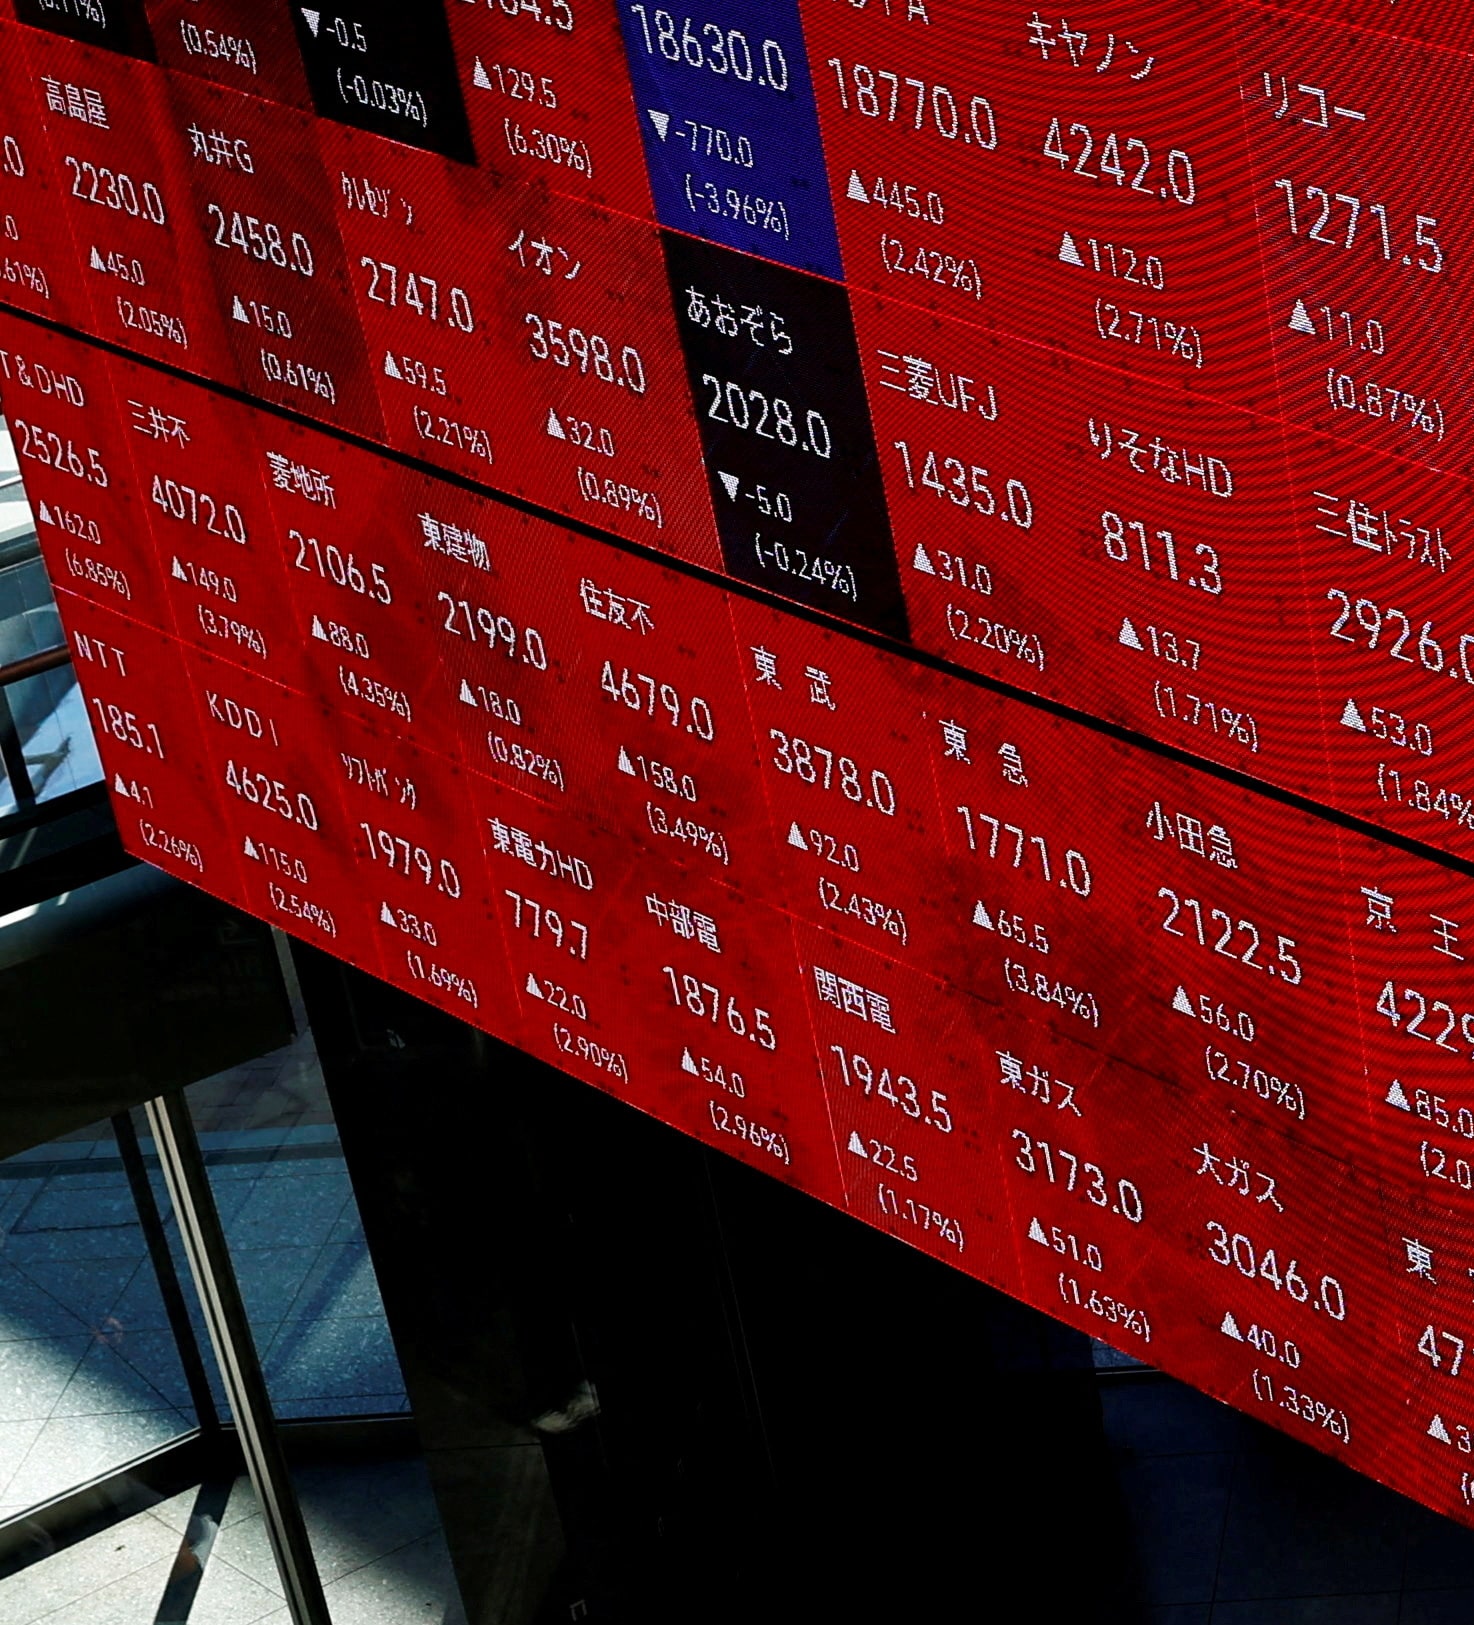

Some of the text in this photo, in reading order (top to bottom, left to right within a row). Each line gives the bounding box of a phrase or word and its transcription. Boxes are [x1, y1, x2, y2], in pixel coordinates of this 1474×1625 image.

[326, 17, 367, 52] -0.5
[631, 4, 788, 91] 18630.0
[1027, 11, 1154, 80] キヤノン
[493, 64, 557, 108] 129.5
[828, 58, 997, 150] 18770.0
[1263, 72, 1366, 128] リコー
[187, 122, 255, 175] 丸井G
[504, 118, 592, 179] (6.30%)
[676, 120, 753, 168] -770.0
[1043, 117, 1197, 206] 4242.0
[65, 156, 165, 225] 2230.0
[685, 173, 789, 240] (-3.96%)
[208, 204, 314, 277] 2458.0
[508, 230, 582, 281] イオン
[1275, 178, 1443, 274] 1271.5
[361, 256, 475, 333] 2747.0
[685, 286, 793, 355] あおぞら
[525, 313, 646, 393] 3598.0
[1095, 298, 1203, 369] (2.71%)
[702, 373, 831, 459] 2028.0
[877, 350, 999, 422] 三菱UFJ
[17, 420, 108, 488] 2526.5
[128, 399, 191, 449] 三井不
[1088, 418, 1233, 498] りそなHD
[152, 475, 247, 545] 4072.0
[745, 485, 792, 523] -5.0
[894, 441, 1032, 529] 1435.0
[289, 529, 391, 605] 2106.5
[417, 512, 492, 572] 東建物
[755, 532, 857, 602] (-0.24%)
[1101, 510, 1223, 595] 811.3
[437, 591, 547, 670] 2199.0
[580, 577, 654, 635] 住友不
[1147, 625, 1200, 670] 13.7
[93, 698, 165, 759] 185.1
[601, 661, 714, 741] 4679.0
[226, 760, 318, 831] 4625.0
[770, 729, 895, 816] 3878.0
[360, 823, 460, 898] 1979.0
[487, 818, 593, 891] 東電力HD
[957, 806, 1091, 897] 1771.0
[1146, 801, 1238, 869] 小田急
[269, 882, 336, 937] (2.54%)
[505, 890, 588, 959] 779.7
[645, 893, 721, 954] 中部電
[1157, 887, 1302, 985] 2122.5
[544, 980, 587, 1020] 22.0
[663, 966, 776, 1050] 1876.5
[813, 965, 896, 1035] 関西電
[553, 1023, 628, 1084] (2.90%)
[995, 1050, 1083, 1117] 東ガス
[831, 1045, 952, 1133] 1943.5
[870, 1139, 918, 1182] 22.5
[1012, 1129, 1143, 1223] 3173.0
[1193, 1142, 1283, 1213] 大ガス
[1206, 1220, 1346, 1321] 3046.0
